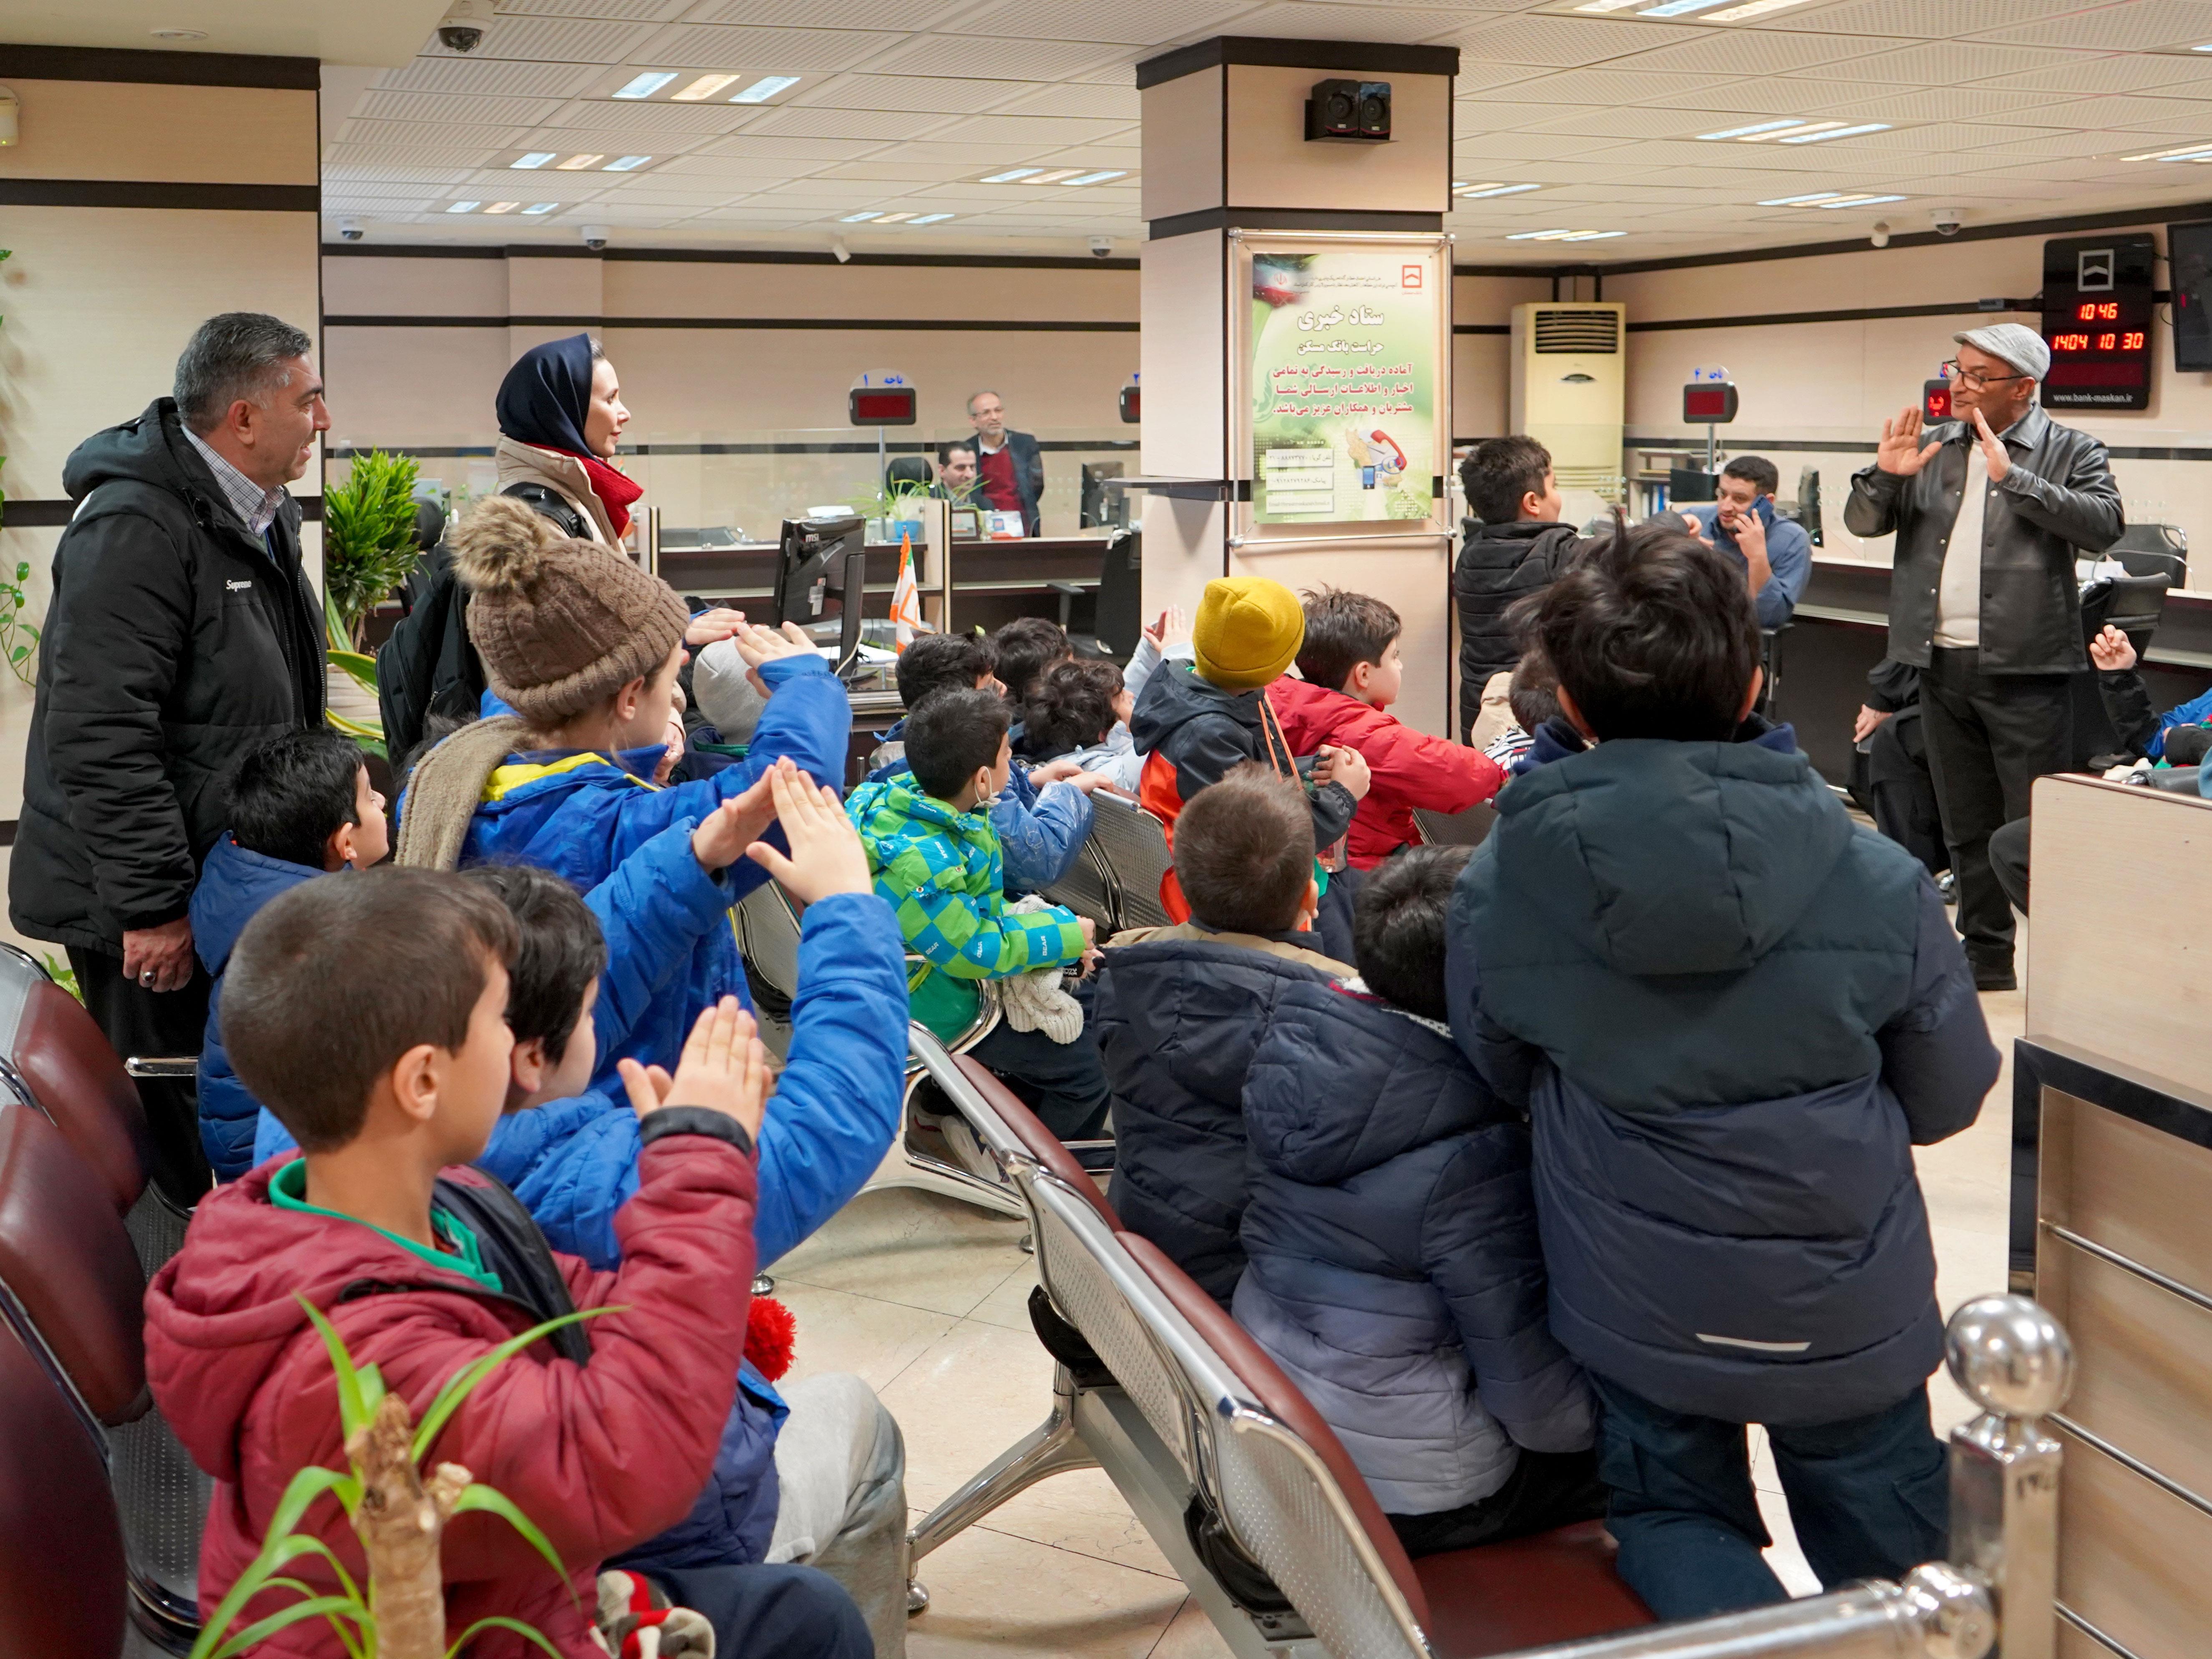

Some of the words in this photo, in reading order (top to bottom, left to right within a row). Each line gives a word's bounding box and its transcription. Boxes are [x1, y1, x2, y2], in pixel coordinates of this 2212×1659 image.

[1297, 305, 1345, 332] خبری
[1348, 305, 1385, 325] ستاد
[1297, 340, 1325, 355] مسکن
[1326, 340, 1349, 355] بانک
[1351, 340, 1384, 355] حراست
[2053, 334, 2089, 350] 1404
[2100, 333, 2116, 350] 10
[2122, 332, 2144, 349] 30
[1273, 365, 1298, 378] تمامی
[1301, 367, 1309, 377] به
[1312, 365, 1346, 378] رسیدگی
[1349, 369, 1353, 378] و
[1356, 365, 1386, 378] دریافت
[1389, 364, 1413, 374] آماده
[884, 375, 903, 387] باجه
[1276, 385, 1298, 394] شما
[1301, 384, 1337, 397] ارسالی
[1341, 384, 1380, 393] اطلاعات
[1383, 388, 1388, 396] و
[1391, 383, 1413, 396] اخبار
[2053, 393, 2133, 403] www.bank-maskan.ir
[1312, 405, 1331, 416] عزیز
[1334, 403, 1369, 415] همکاران
[1371, 407, 1376, 415] و
[1379, 403, 1412, 415] مشتریان
[226, 579, 252, 592] Supreme
[934, 841, 948, 859] GEAR
[925, 942, 939, 955] GEAR
